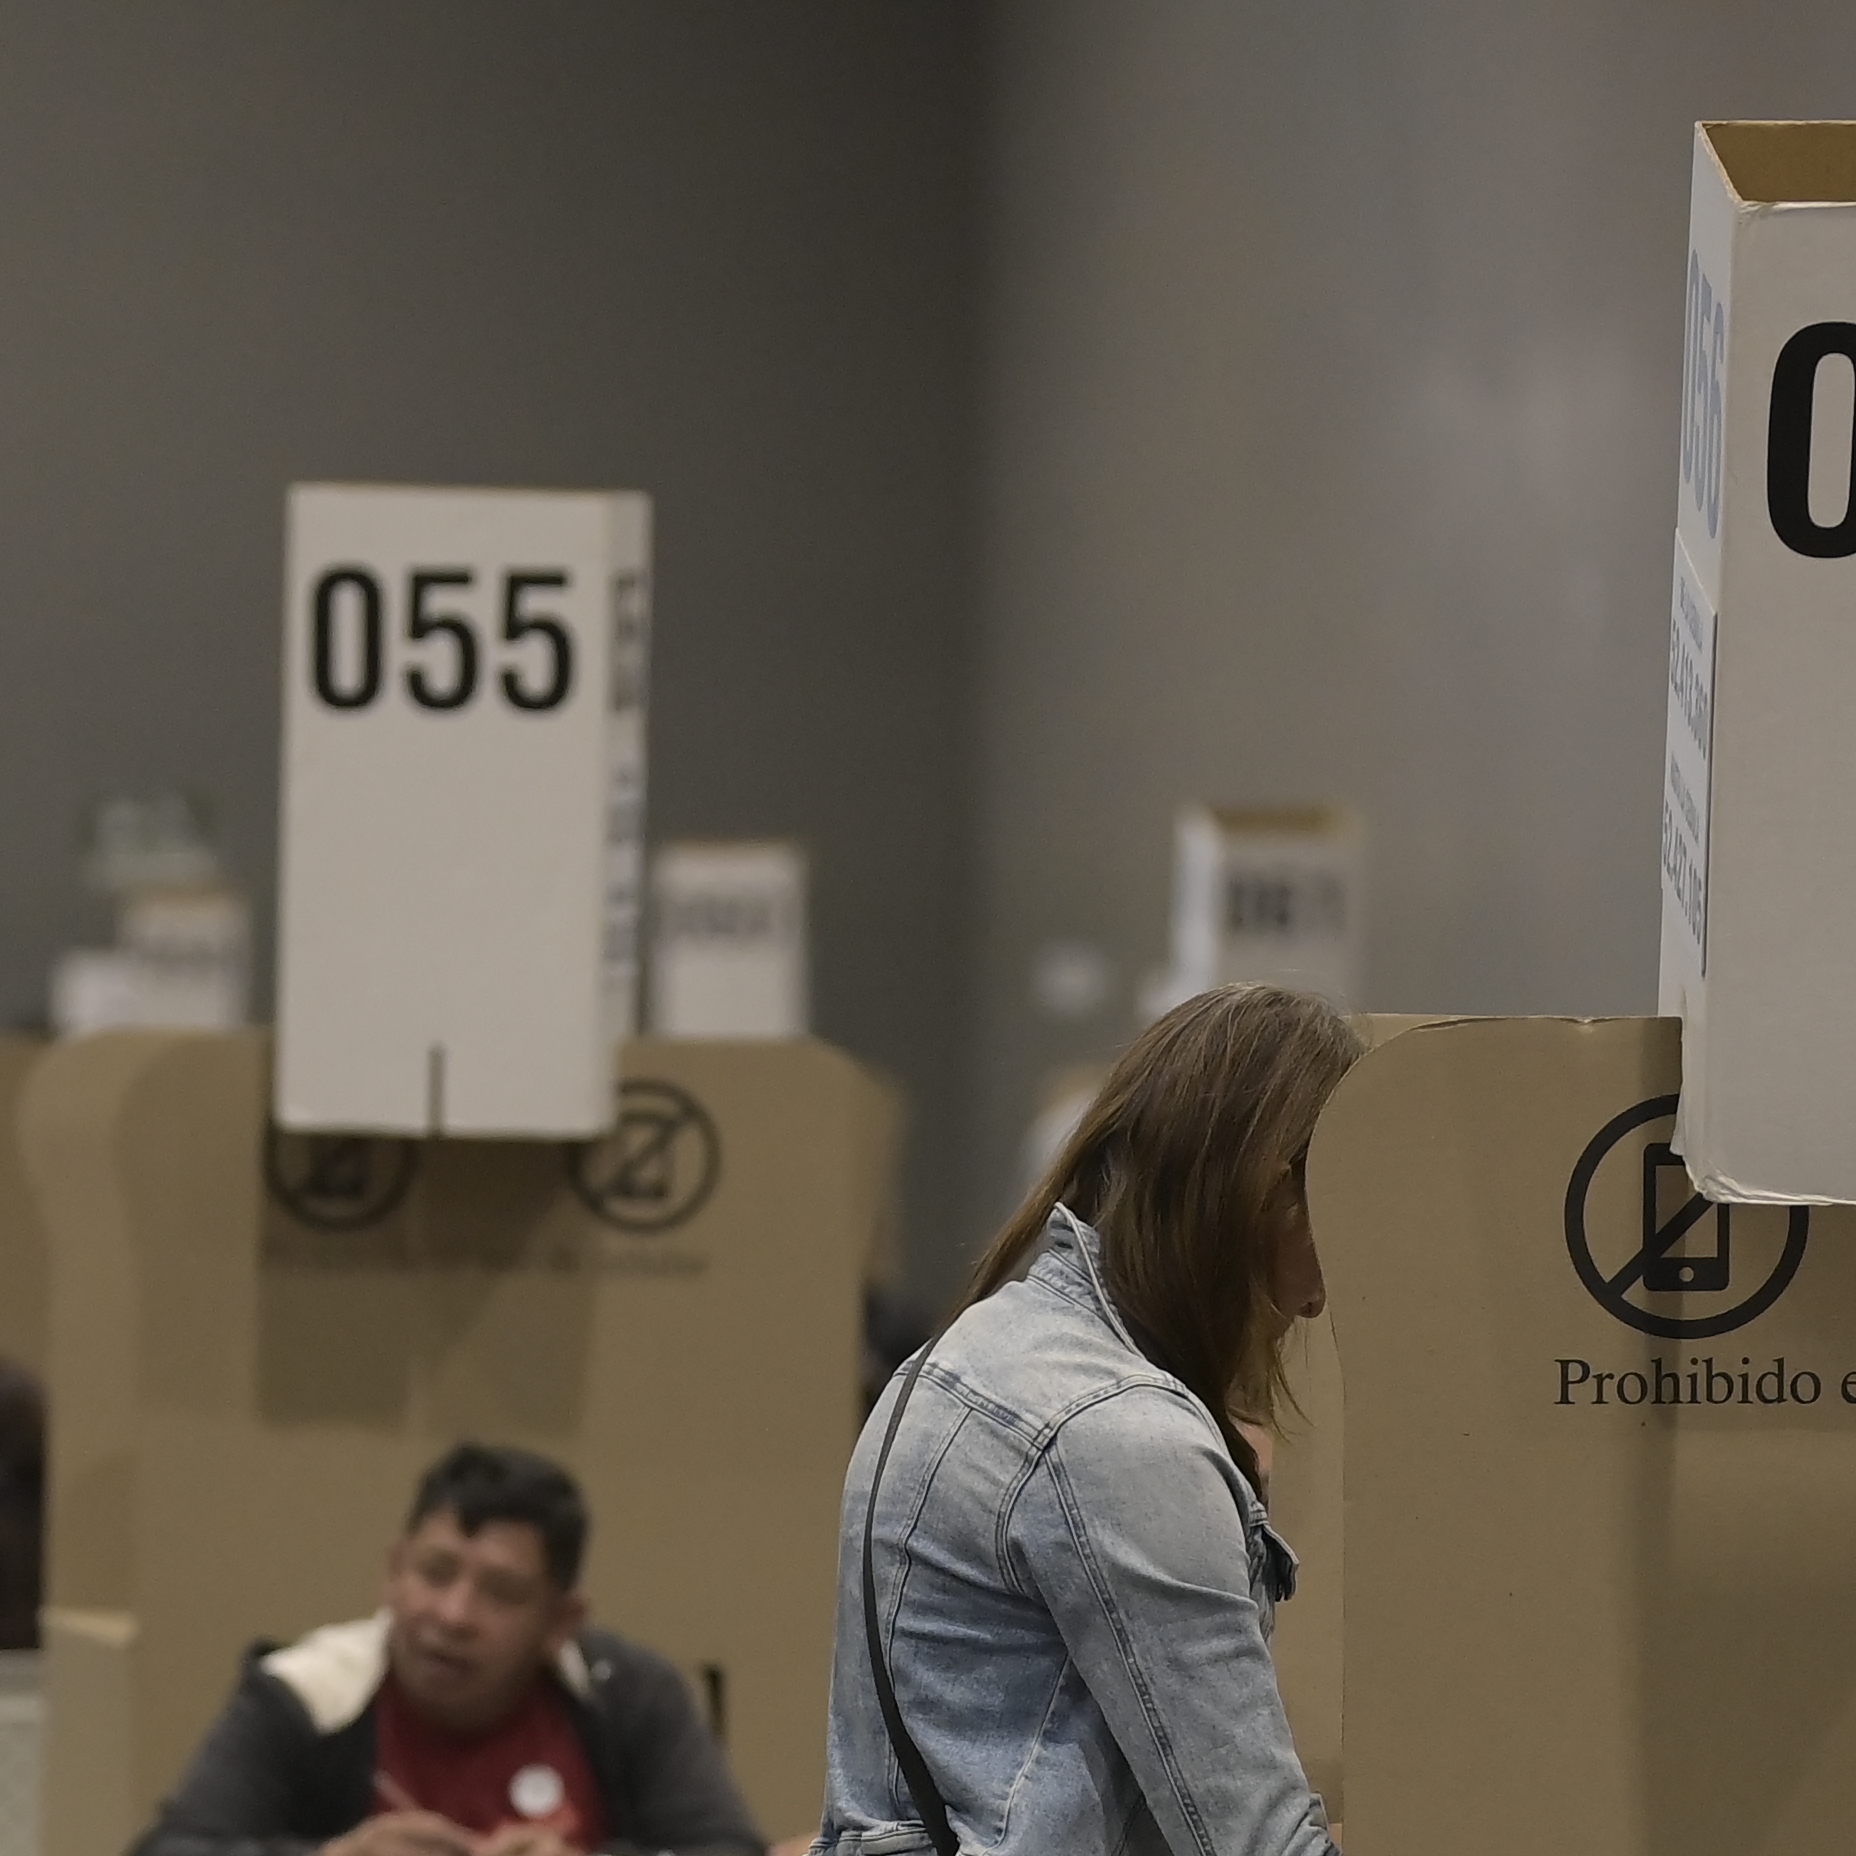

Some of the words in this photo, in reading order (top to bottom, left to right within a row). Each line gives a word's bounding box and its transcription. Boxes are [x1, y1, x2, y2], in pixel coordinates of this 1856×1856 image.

[1681, 248, 1726, 540] 056
[310, 563, 576, 715] 055
[1554, 1356, 1823, 1406] Prohibido
